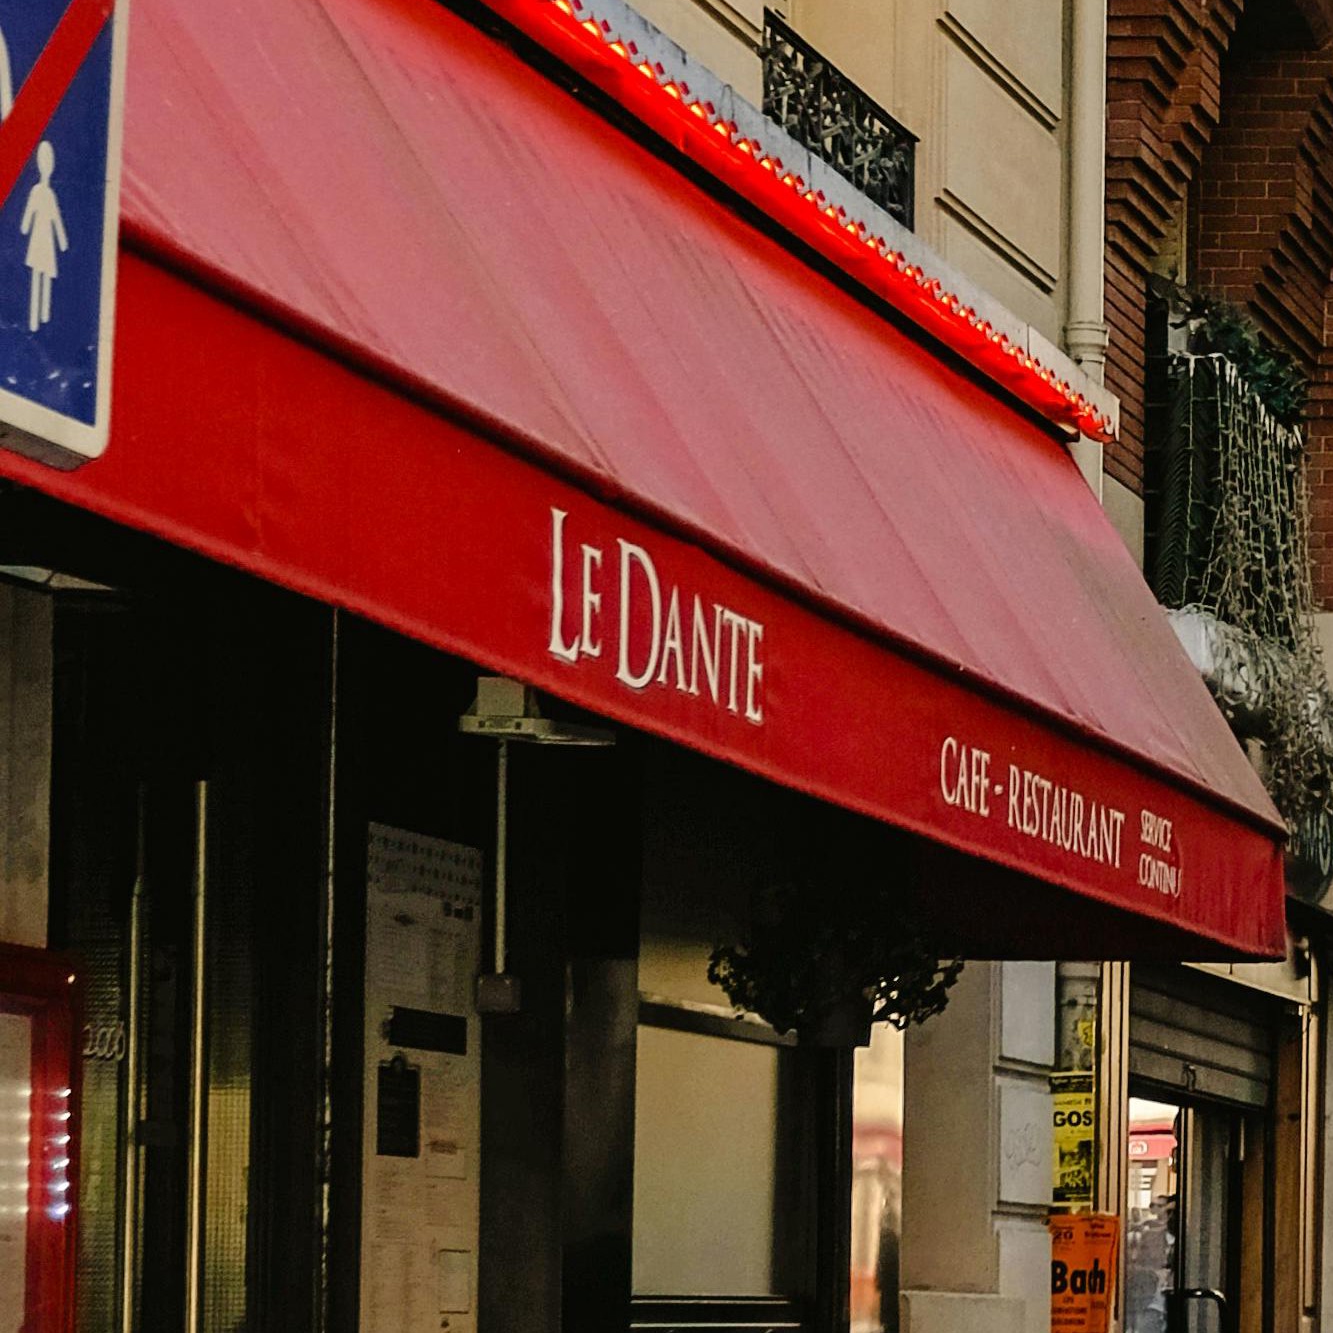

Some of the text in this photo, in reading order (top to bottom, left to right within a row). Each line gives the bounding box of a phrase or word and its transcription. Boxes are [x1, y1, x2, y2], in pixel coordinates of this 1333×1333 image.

[548, 506, 763, 723] LE DANTE
[1008, 764, 1124, 868] RESTAURANT
[1140, 808, 1172, 853] SERVICE
